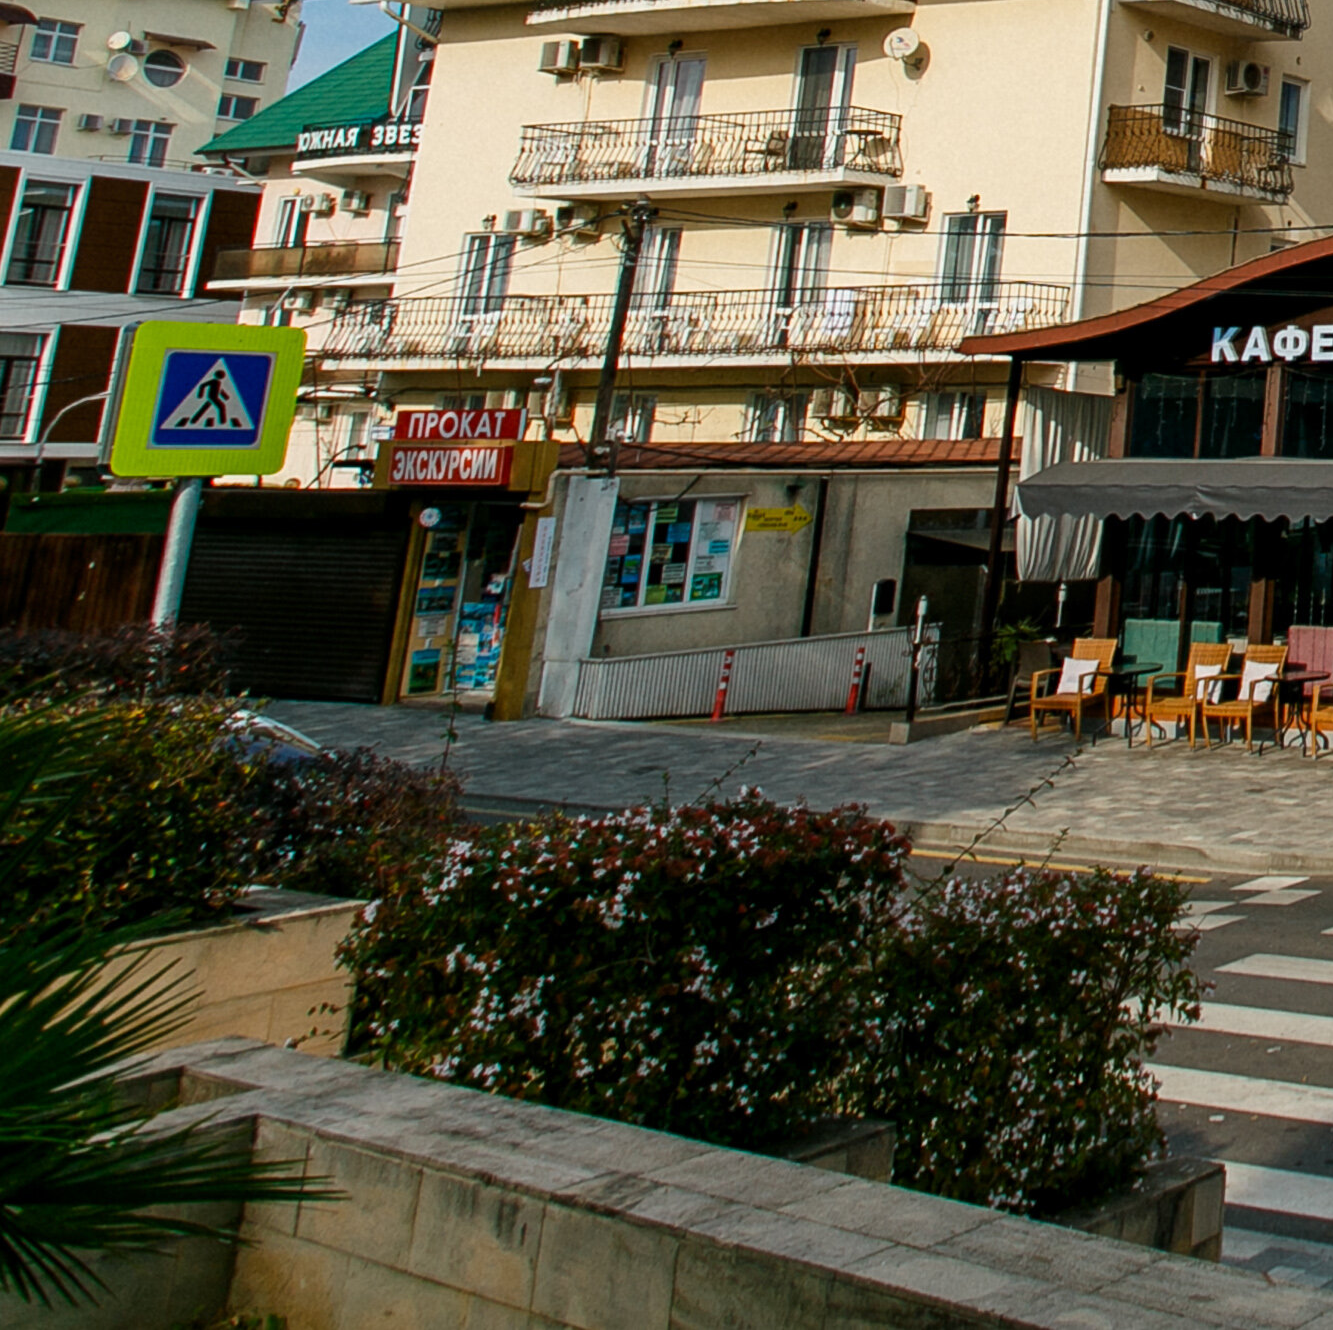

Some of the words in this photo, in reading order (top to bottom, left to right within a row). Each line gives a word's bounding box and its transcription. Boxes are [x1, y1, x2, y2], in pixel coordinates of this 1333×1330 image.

[297, 127, 360, 152] ЮЖНАЯ
[408, 411, 506, 439] ПРОКАТ
[393, 449, 499, 481] ЭКСКУРСИИ
